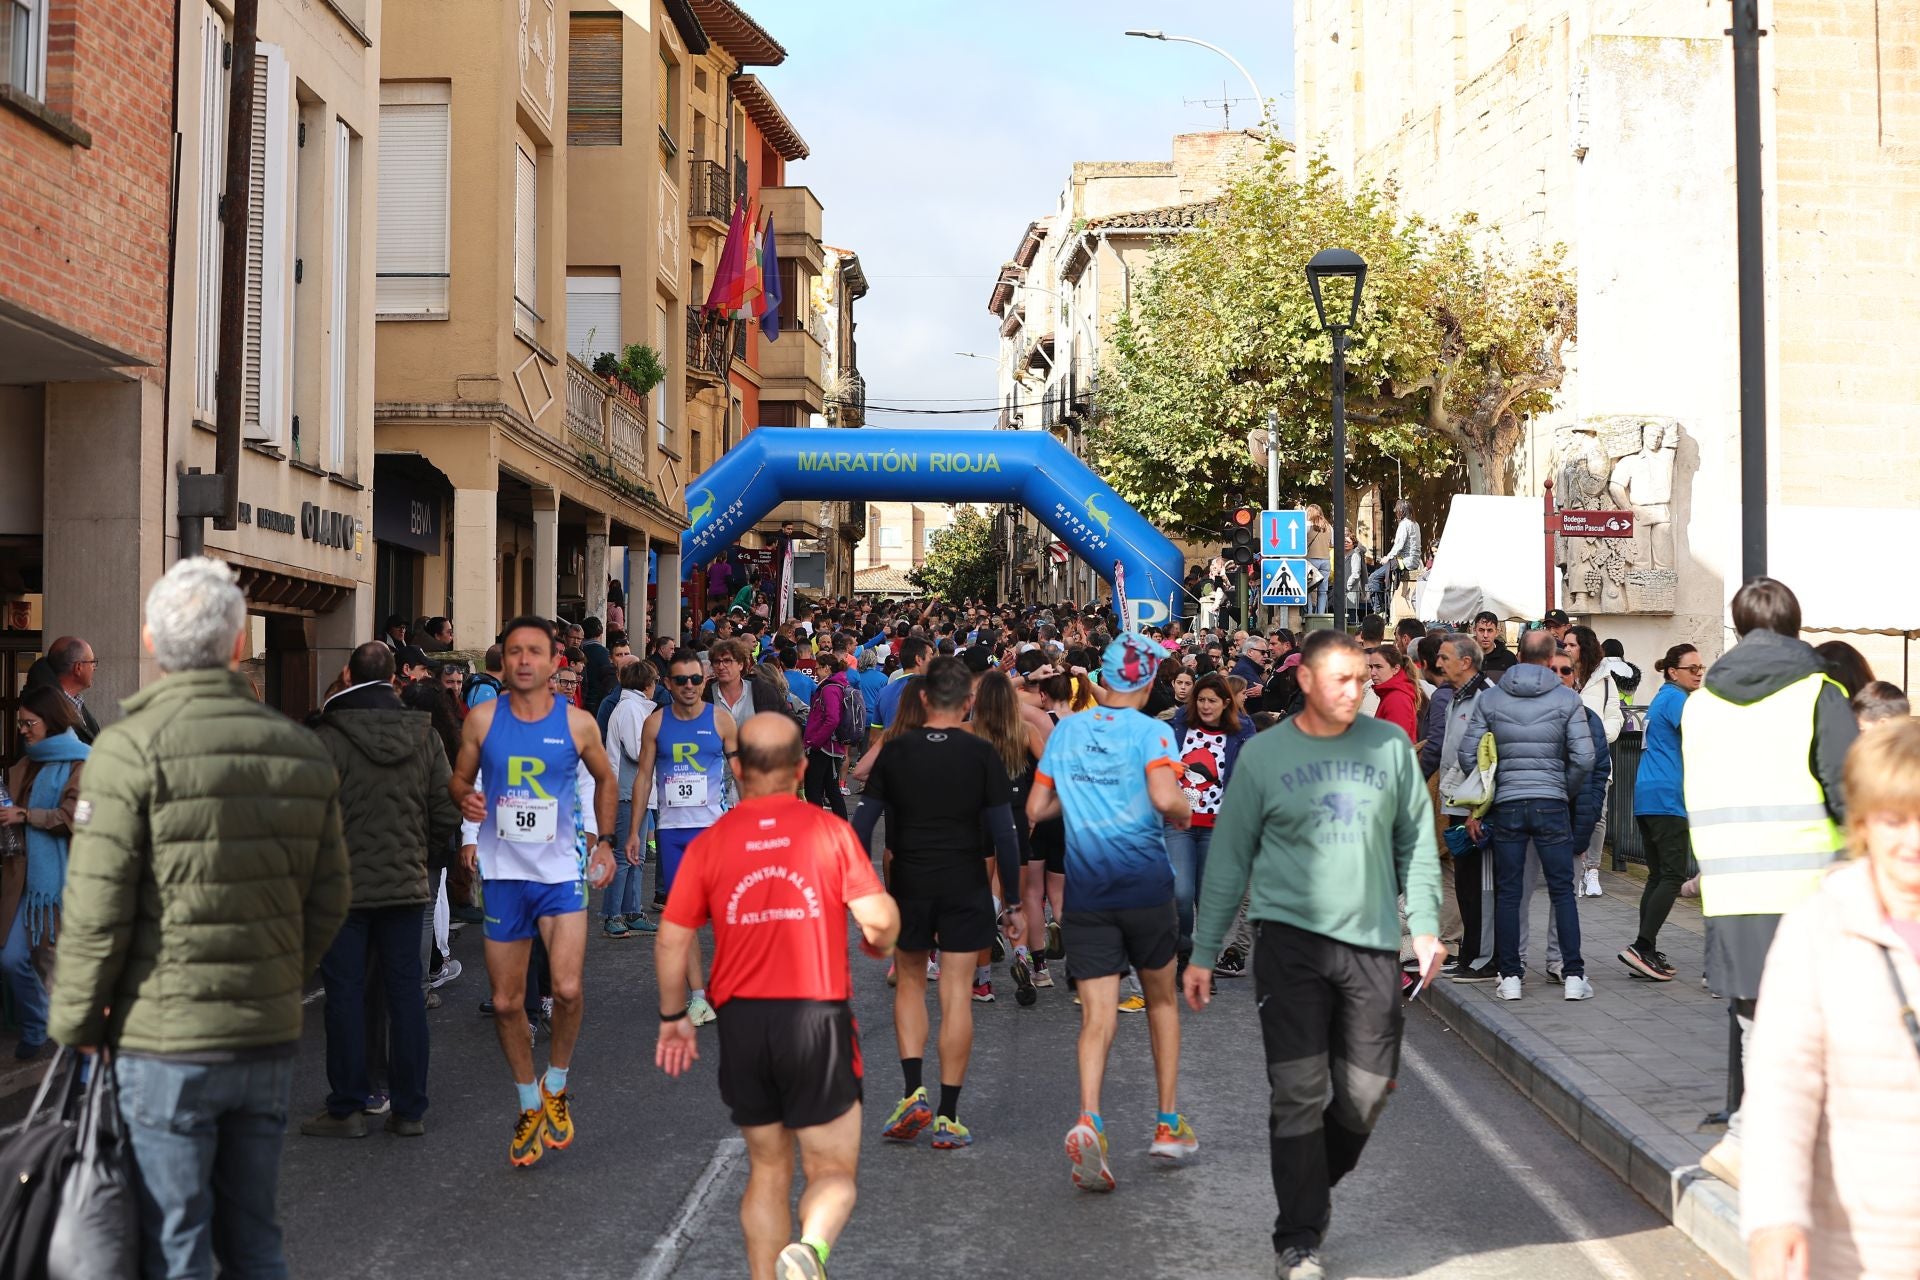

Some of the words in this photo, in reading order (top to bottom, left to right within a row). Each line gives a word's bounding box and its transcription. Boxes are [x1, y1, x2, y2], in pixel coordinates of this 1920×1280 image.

[798, 448, 916, 472] MARATÓN
[929, 452, 1001, 473] RIOJA
[411, 500, 432, 535] BBVA
[692, 499, 743, 545] MARATÓN
[701, 511, 743, 547] RIOJA
[1055, 503, 1107, 549] MARATÓN
[1563, 515, 1586, 524] Bodegas
[1585, 524, 1605, 532] Pascual
[1055, 512, 1096, 550] RIOJA
[674, 764, 689, 772] CLUB
[1281, 759, 1388, 793] PANTHERS
[507, 789, 530, 798] CLUB
[678, 784, 693, 796] 33
[516, 811, 536, 828] 58
[787, 871, 805, 890] AL
[802, 887, 820, 918] MAR
[741, 908, 805, 926] ATLETISMO
